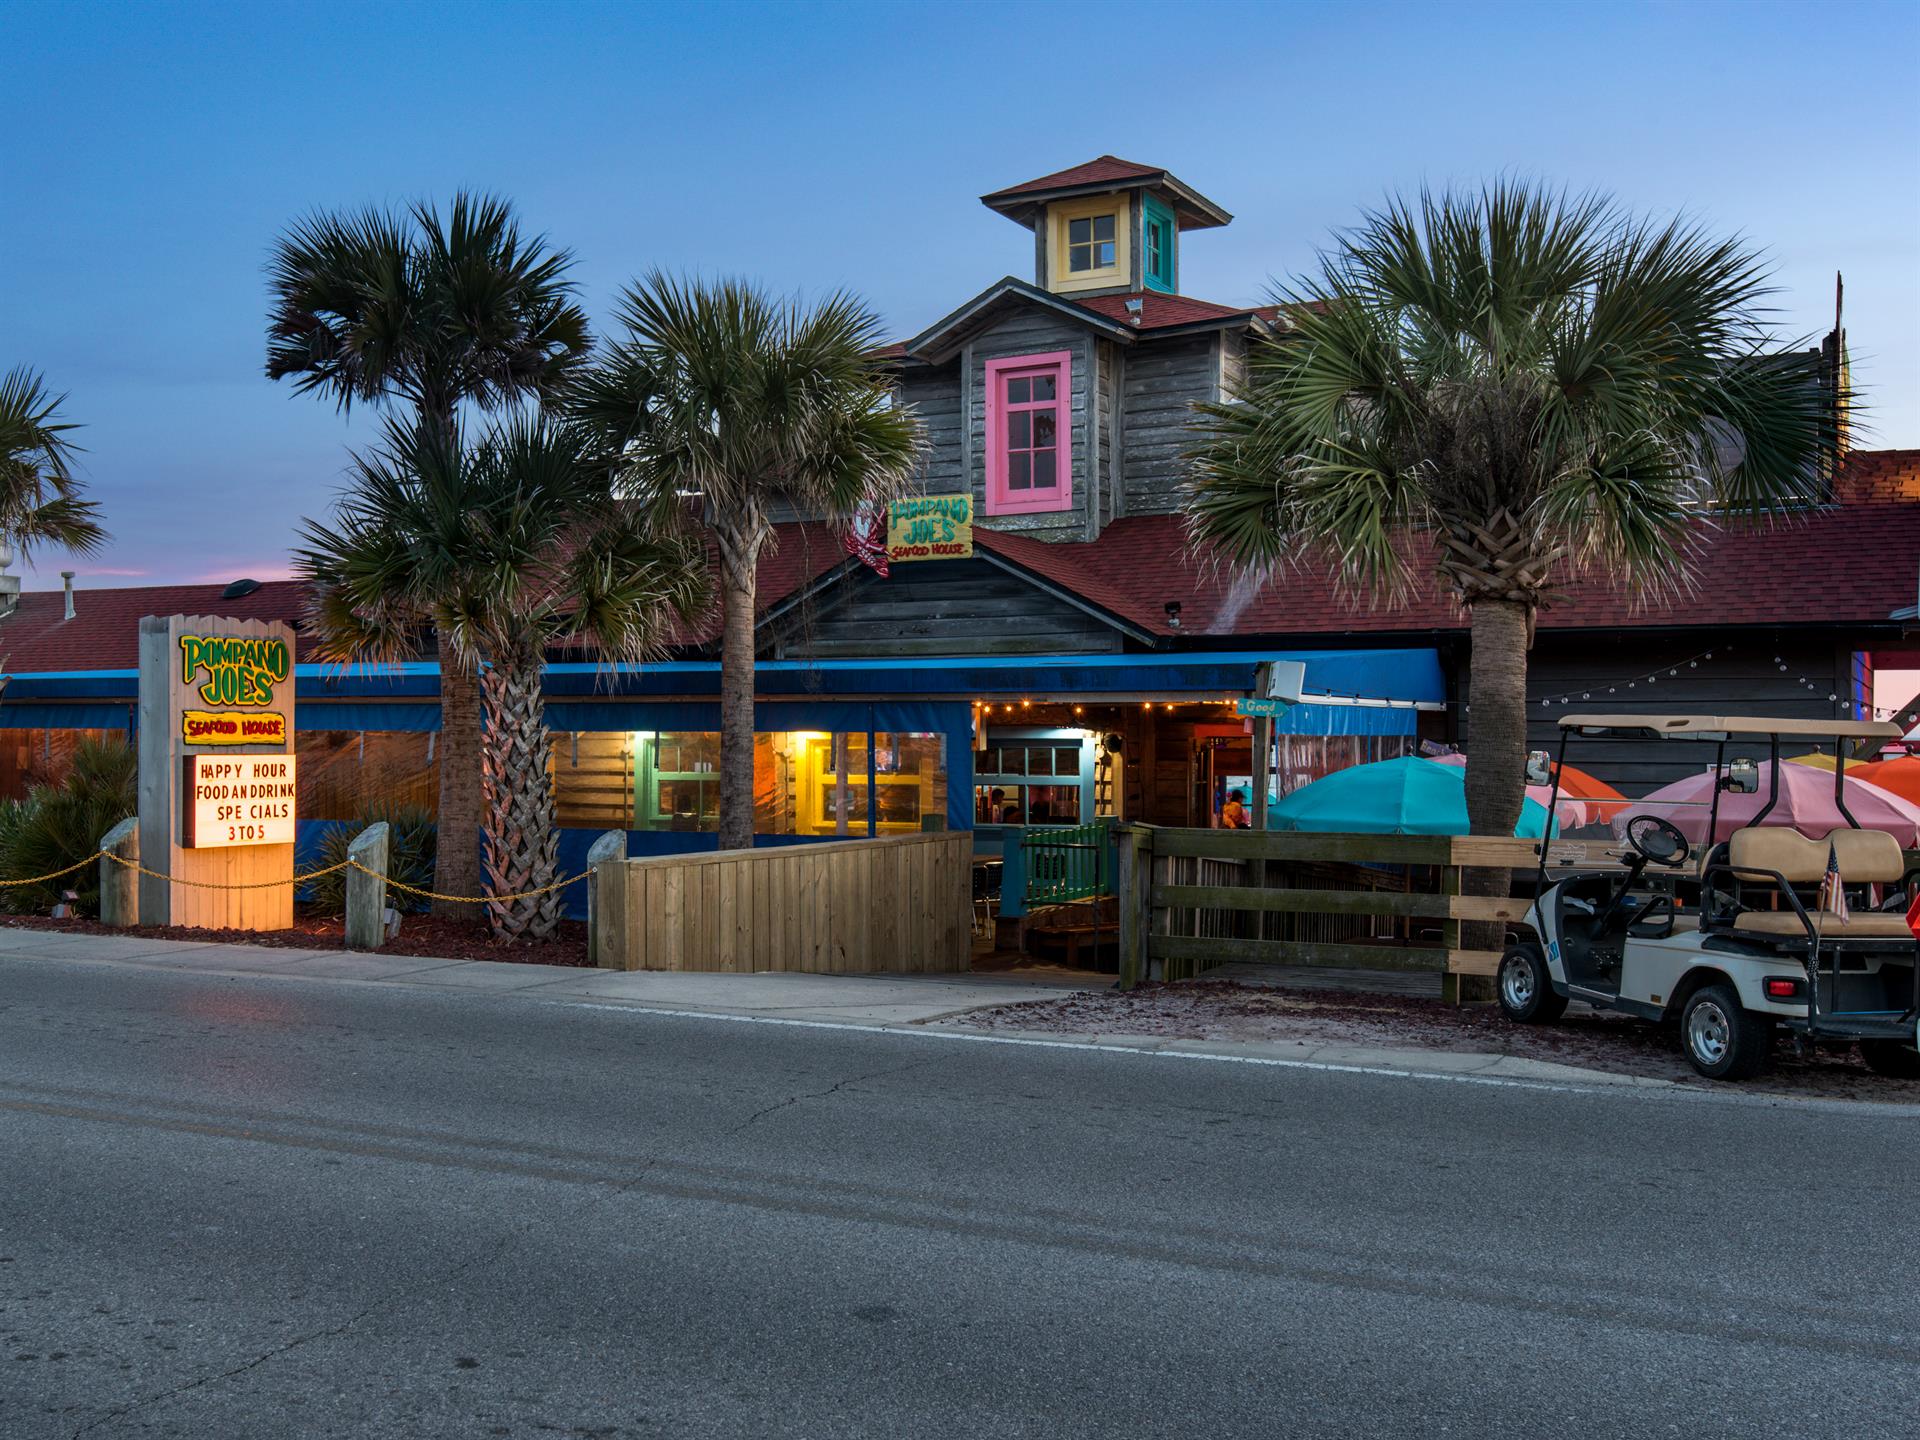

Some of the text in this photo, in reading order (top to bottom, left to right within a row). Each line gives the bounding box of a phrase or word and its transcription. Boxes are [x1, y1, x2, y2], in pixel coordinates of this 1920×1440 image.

[891, 497, 968, 529] POMPANO
[892, 544, 930, 558] SEAFOOD
[180, 636, 289, 683] POMPANO
[200, 665, 273, 705] JOES
[1246, 700, 1276, 712] Good
[187, 720, 282, 736] SEAFOOD HOUSE
[200, 763, 287, 779] HAPPY HOUR
